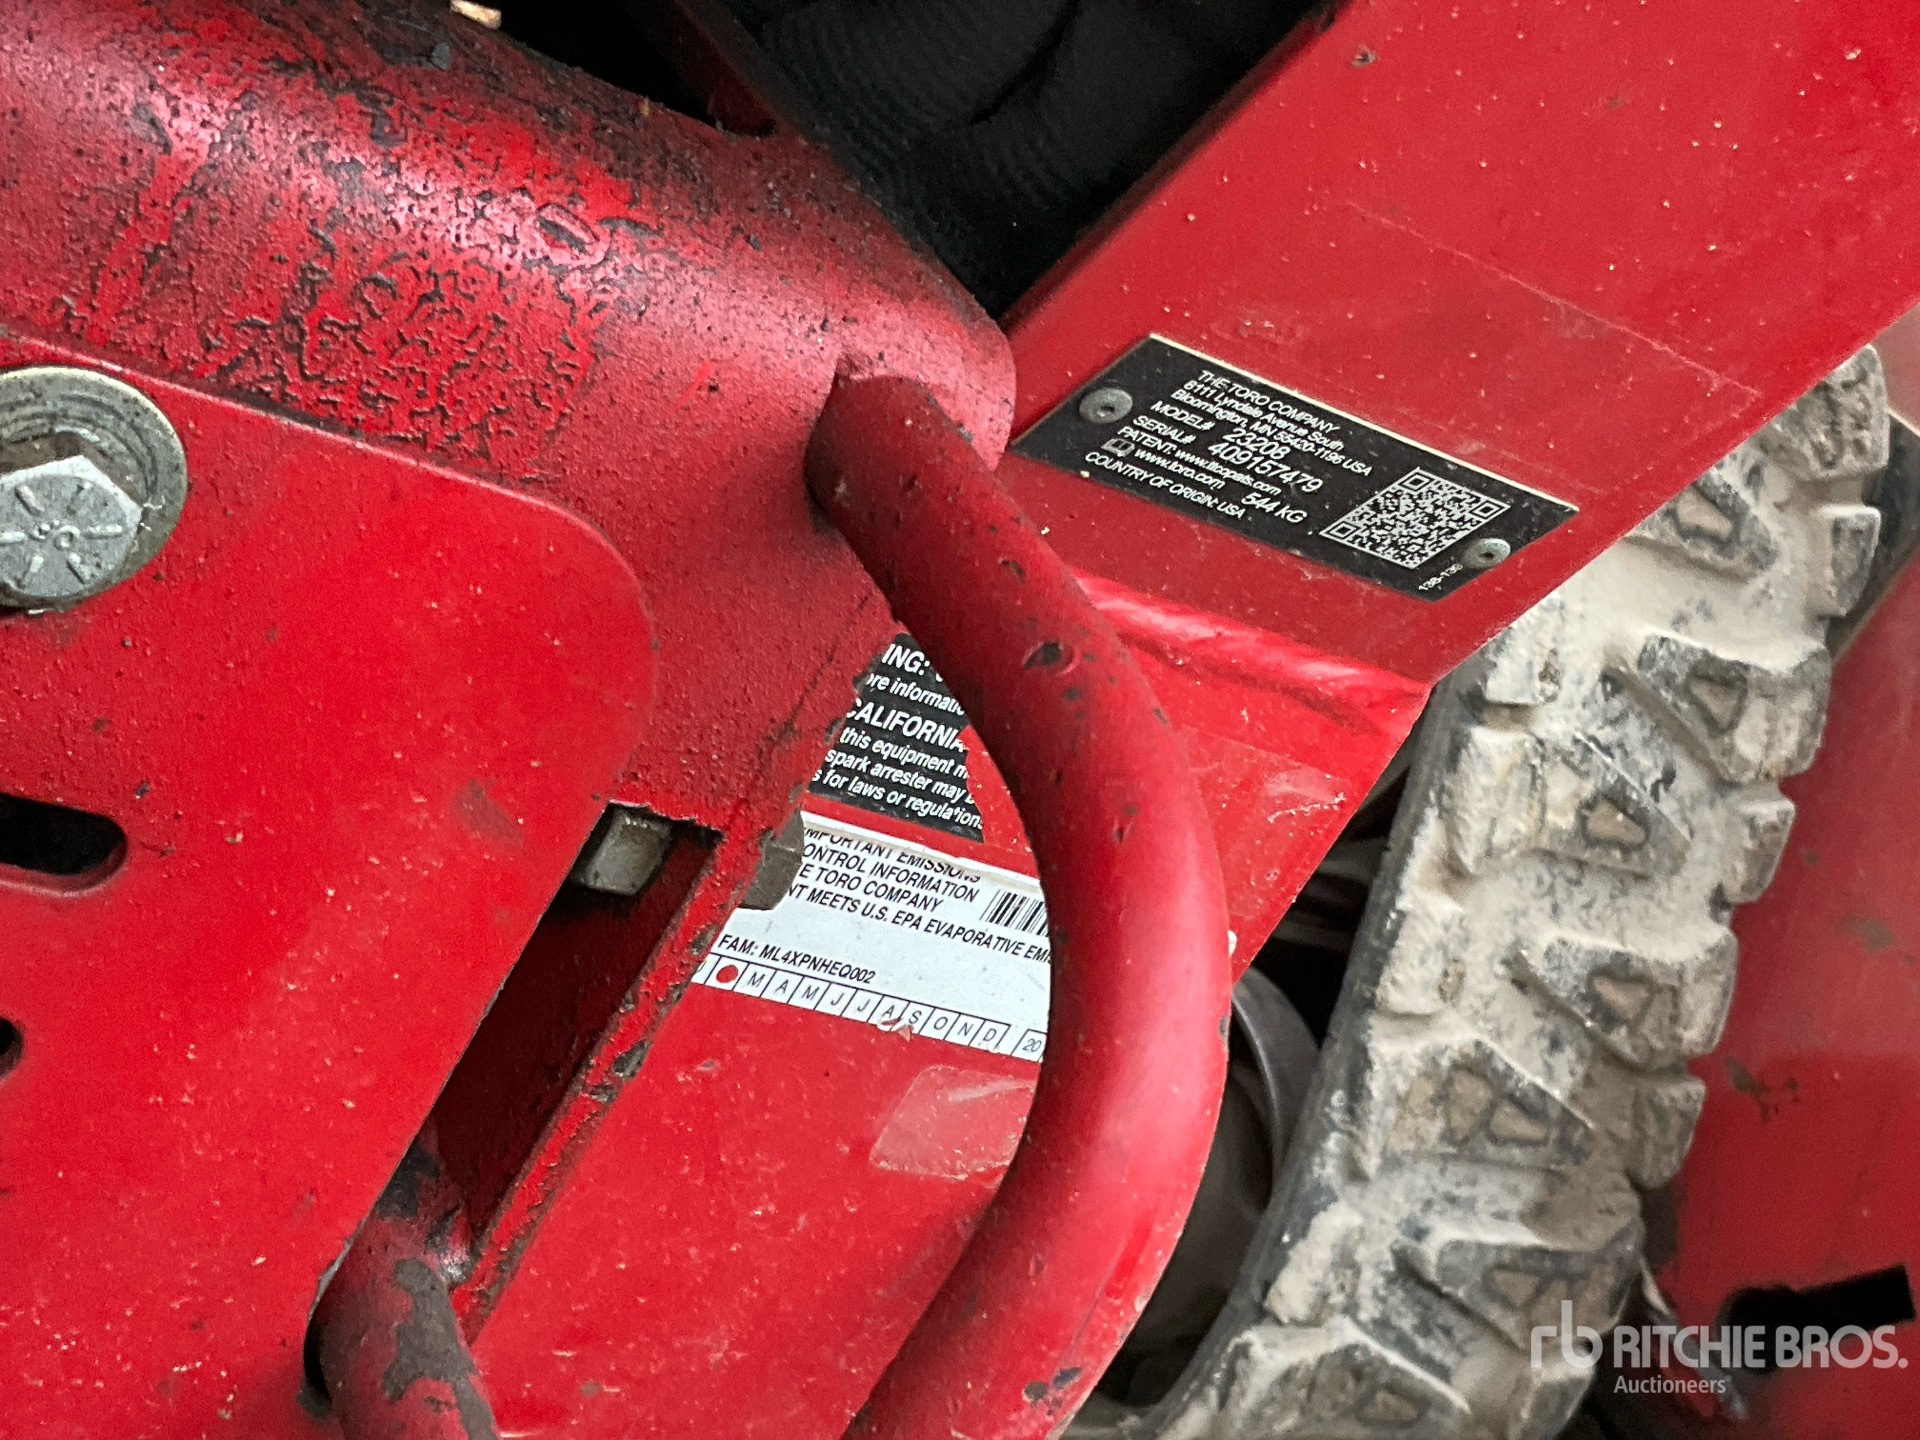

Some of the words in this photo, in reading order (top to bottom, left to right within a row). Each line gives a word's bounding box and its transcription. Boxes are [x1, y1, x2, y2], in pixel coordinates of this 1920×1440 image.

[1150, 400, 1216, 430] MODEL#
[1222, 428, 1291, 459] 23208
[1184, 380, 1217, 398] 8111
[1214, 392, 1263, 417] Lyndale
[1260, 413, 1308, 436] Avenue
[1307, 431, 1344, 451] South
[1198, 370, 1231, 389] THE
[1228, 383, 1270, 405] TORO
[1268, 401, 1340, 433] COMPANY
[1117, 426, 1177, 455] PATENT:
[1133, 415, 1196, 444] SERIAL#
[1207, 442, 1324, 492] 409157479
[1170, 389, 1248, 428] Bloomington,
[1249, 421, 1278, 436] MN
[1273, 431, 1345, 464] 55420-1196
[1342, 458, 1372, 476] USA
[1085, 452, 1154, 481] COUNTRY
[1149, 476, 1173, 488] OF
[1169, 484, 1218, 508] ORIGIN:
[1217, 501, 1246, 518] USA
[1134, 449, 1225, 490] www.toro.com
[1241, 492, 1280, 512] 544
[1274, 505, 1307, 523] kG
[825, 749, 871, 774] spark
[870, 763, 932, 790] arrester
[931, 781, 966, 804] may
[840, 726, 871, 750] this
[872, 738, 955, 775] equipment
[823, 769, 848, 789] for
[848, 776, 886, 800] laws
[886, 792, 907, 806] or
[815, 867, 862, 891] TORO
[863, 880, 944, 912] COMPANY
[869, 861, 980, 903] INFORMATION
[806, 887, 861, 913] MEETS
[861, 902, 888, 922] U.S.
[891, 909, 923, 930] EPA
[924, 918, 1025, 956] EVAPORATIVE
[718, 934, 759, 956] FAM:
[759, 944, 876, 984] ML4XPNHEQ002
[747, 971, 766, 988] M
[775, 979, 790, 994] A
[802, 985, 820, 1000] M
[830, 992, 845, 1007] J
[857, 999, 871, 1012] J
[881, 1004, 895, 1018] A
[908, 1010, 922, 1024] S
[933, 1016, 948, 1031] O
[957, 1022, 974, 1037] N
[982, 1028, 998, 1042] D
